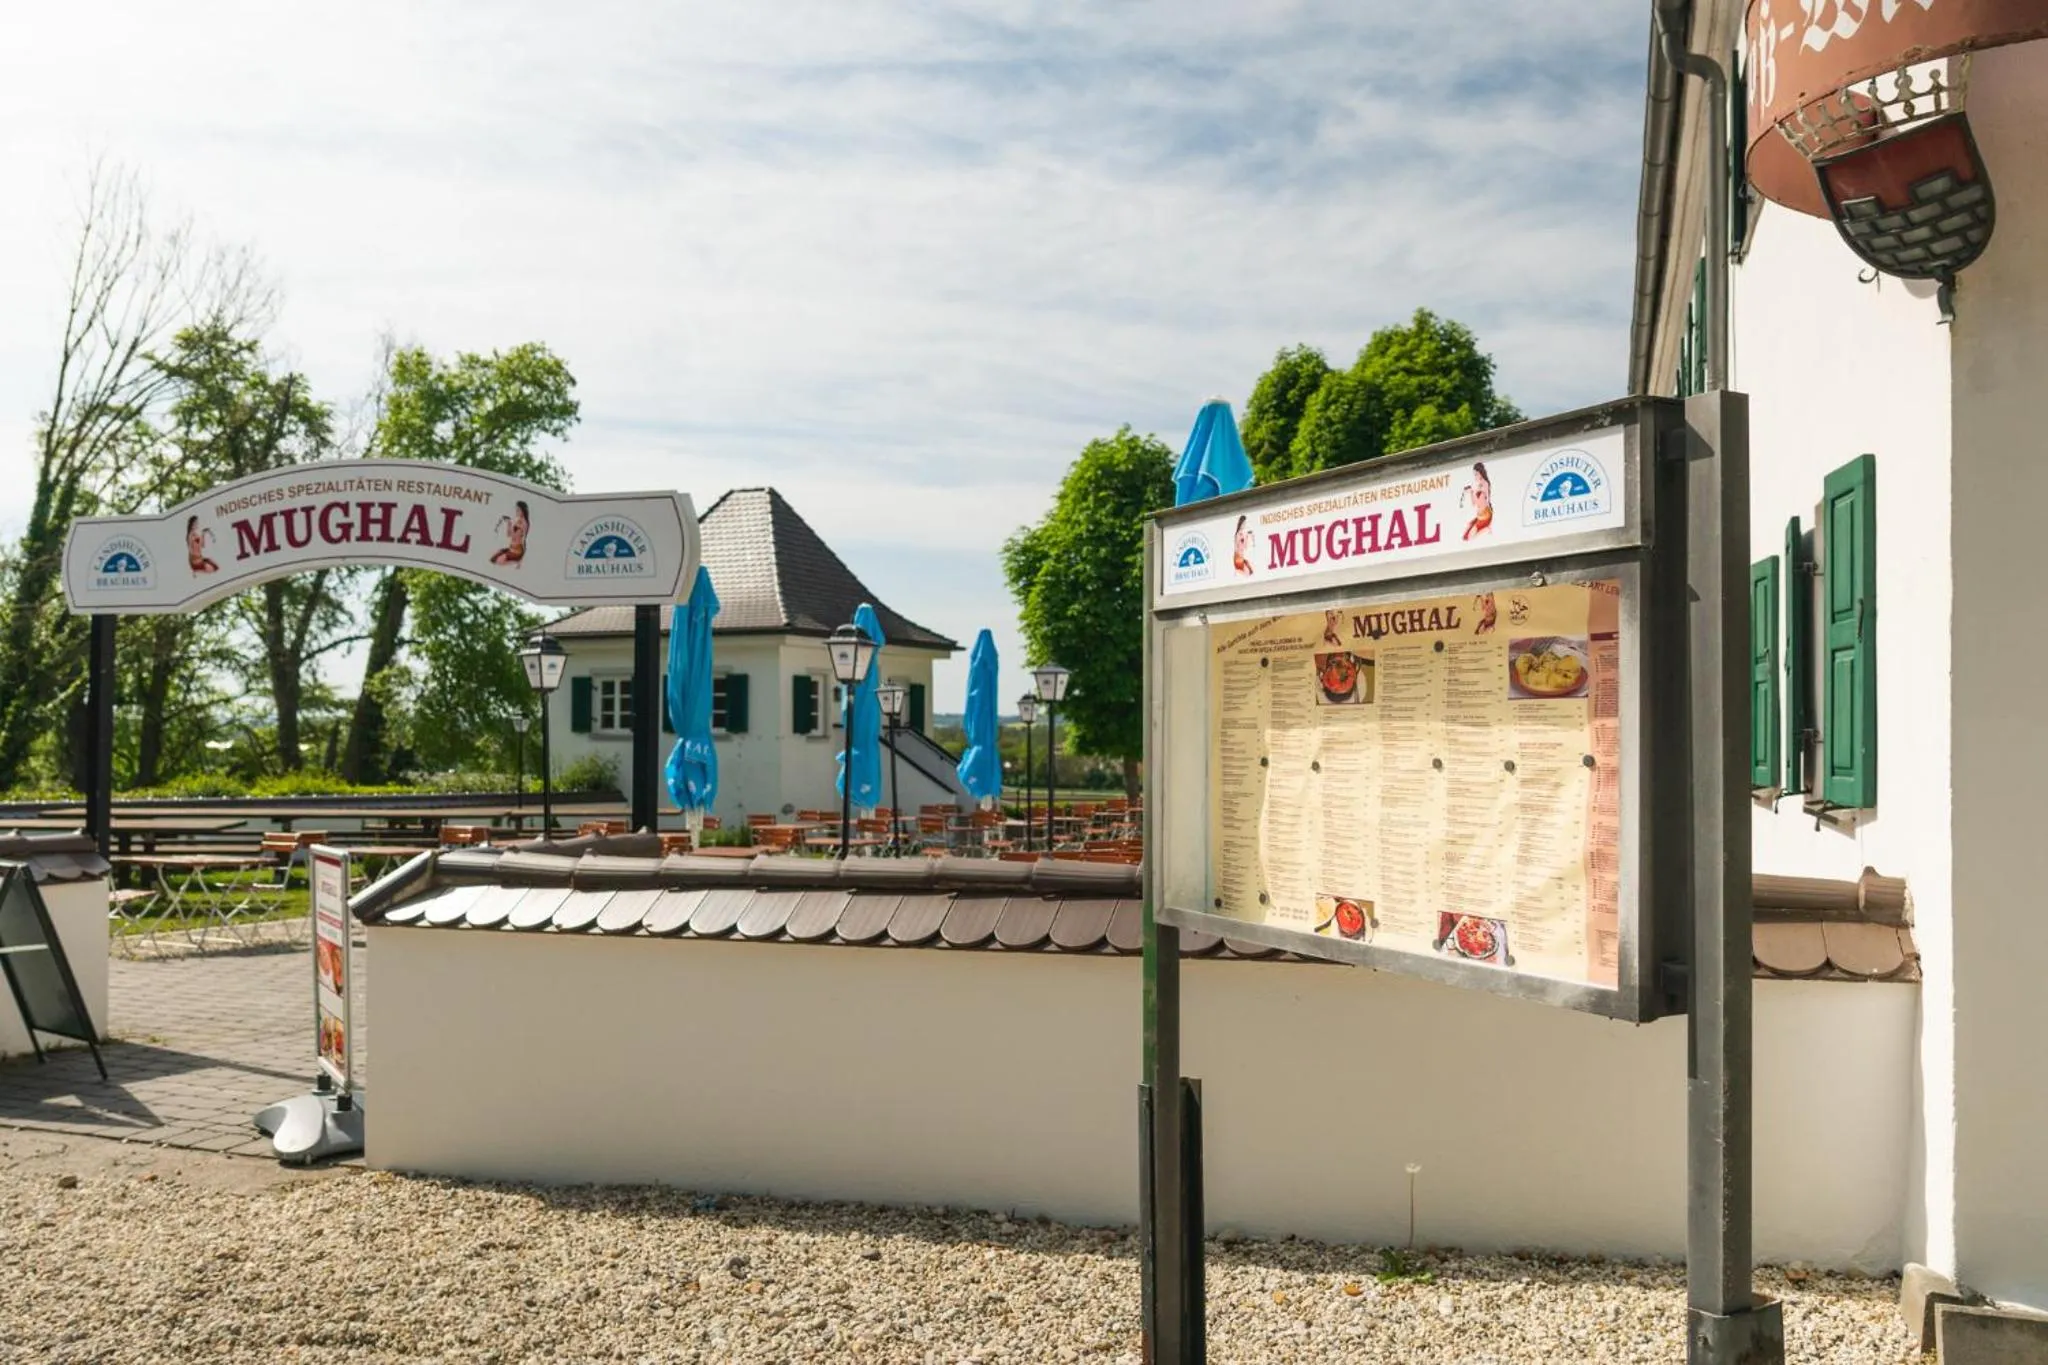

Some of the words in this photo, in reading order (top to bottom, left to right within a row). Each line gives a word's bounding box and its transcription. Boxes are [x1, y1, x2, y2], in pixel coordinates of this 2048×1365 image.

[215, 488, 285, 517] INDISCHES
[287, 477, 393, 499] SPEZIALITÄTEN
[396, 480, 493, 505] RESTAURANT
[1530, 456, 1602, 502] LANDSHUTER
[1260, 505, 1305, 525] INDISCHES
[1307, 490, 1378, 516] SPEZIALITÄTEN
[1380, 474, 1451, 500] RESTAURANT
[1533, 500, 1599, 520] BRAUHAUS
[231, 500, 471, 560] MUGHAL
[573, 521, 647, 557] LANDSHUTER
[1268, 503, 1441, 569] MUGHAL
[577, 562, 644, 576] BRAUHAUS
[1352, 606, 1461, 638] MUGHAL
